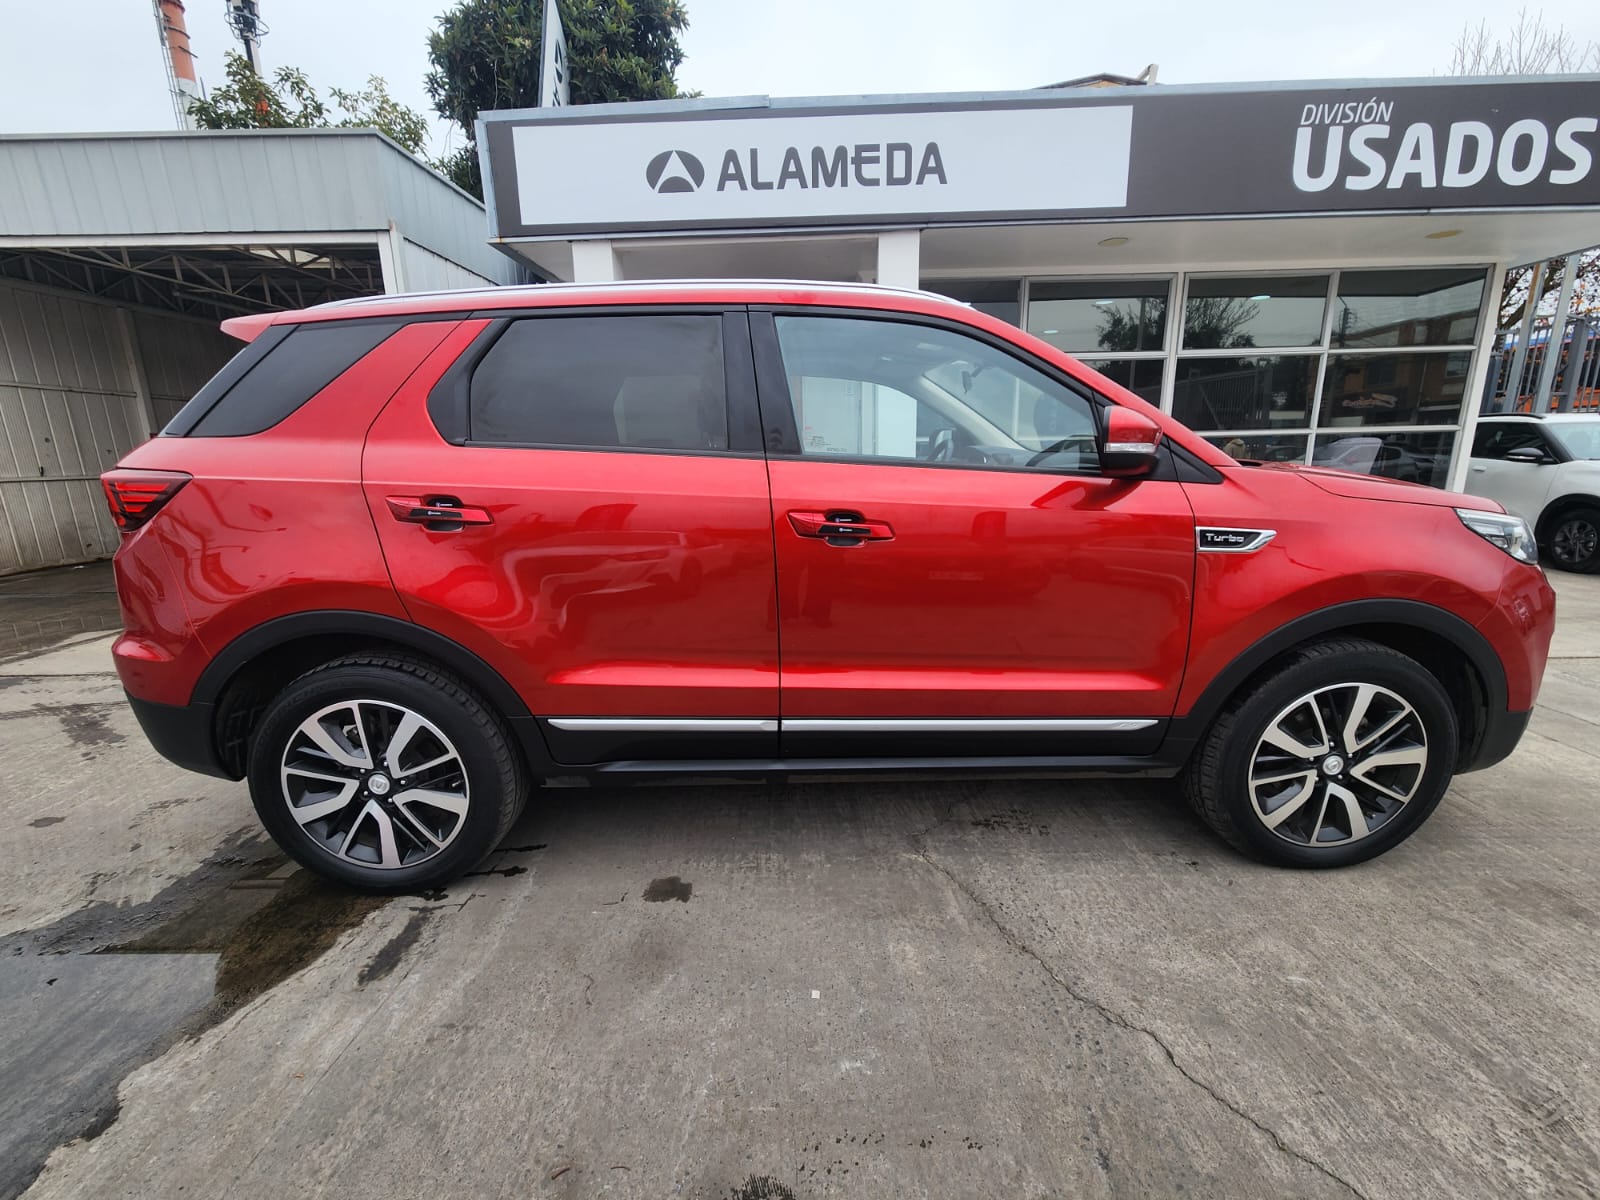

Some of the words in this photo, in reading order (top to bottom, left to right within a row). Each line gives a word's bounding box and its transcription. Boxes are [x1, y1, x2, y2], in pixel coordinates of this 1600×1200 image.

[1300, 96, 1394, 126] DIVISIÓN
[716, 141, 948, 192] ALAMEDA
[1292, 118, 1598, 192] USADOS
[1205, 532, 1245, 543] Turbo
